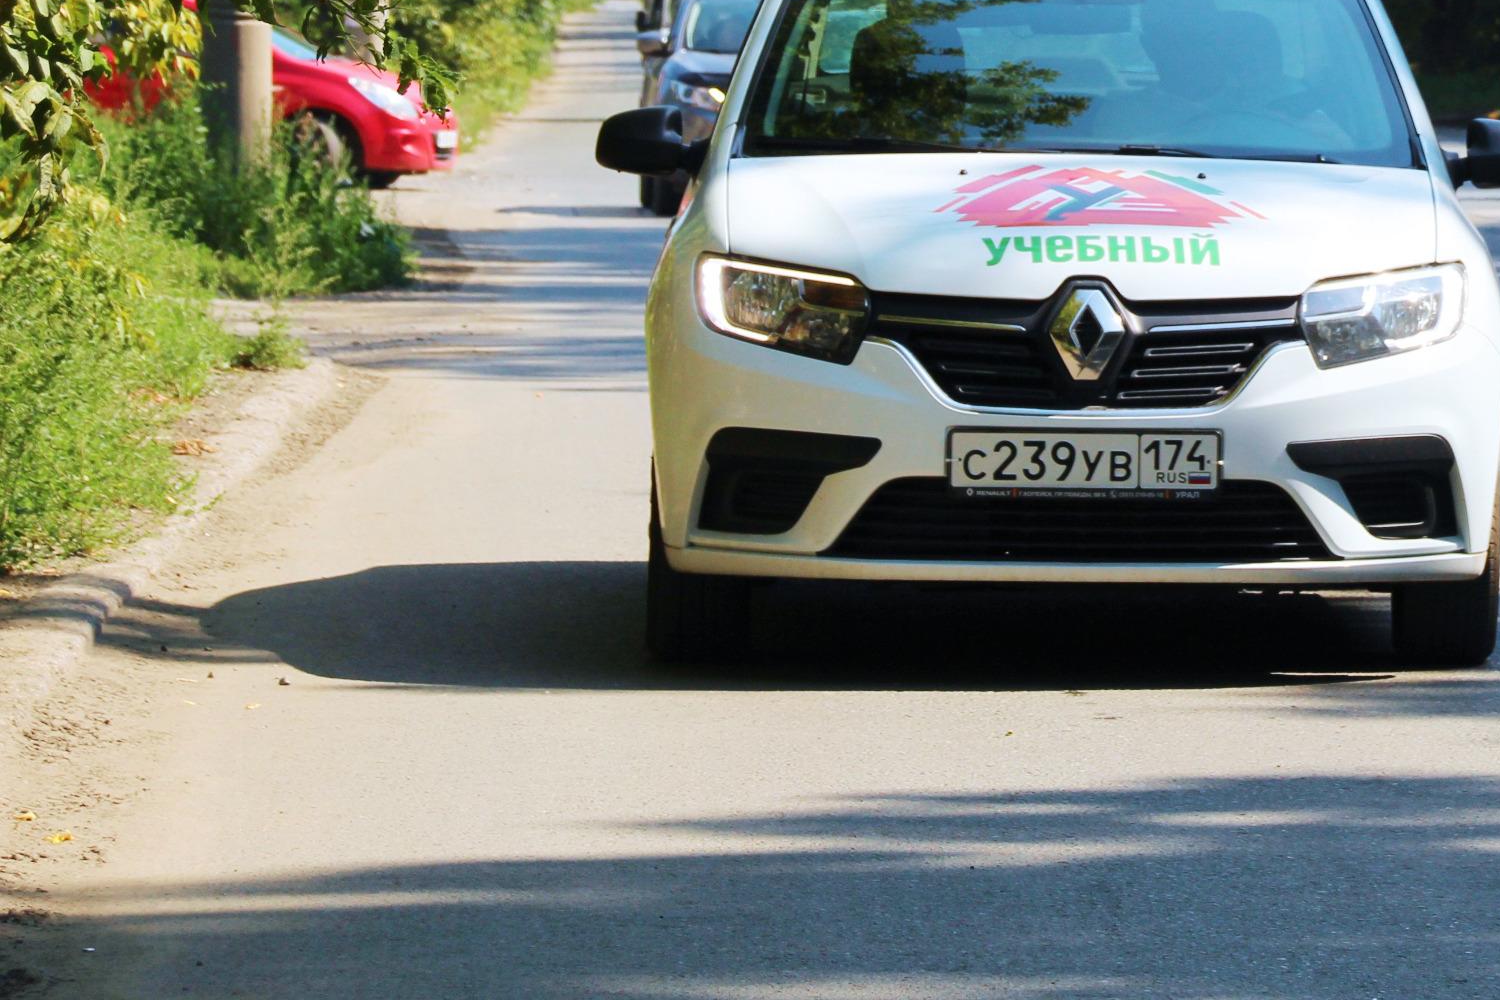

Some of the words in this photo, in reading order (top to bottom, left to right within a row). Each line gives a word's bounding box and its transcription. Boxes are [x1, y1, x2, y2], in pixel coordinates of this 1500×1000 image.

[962, 440, 1132, 482] С239УВ
[1143, 440, 1206, 471] 174
[1156, 472, 1187, 484] RUS
